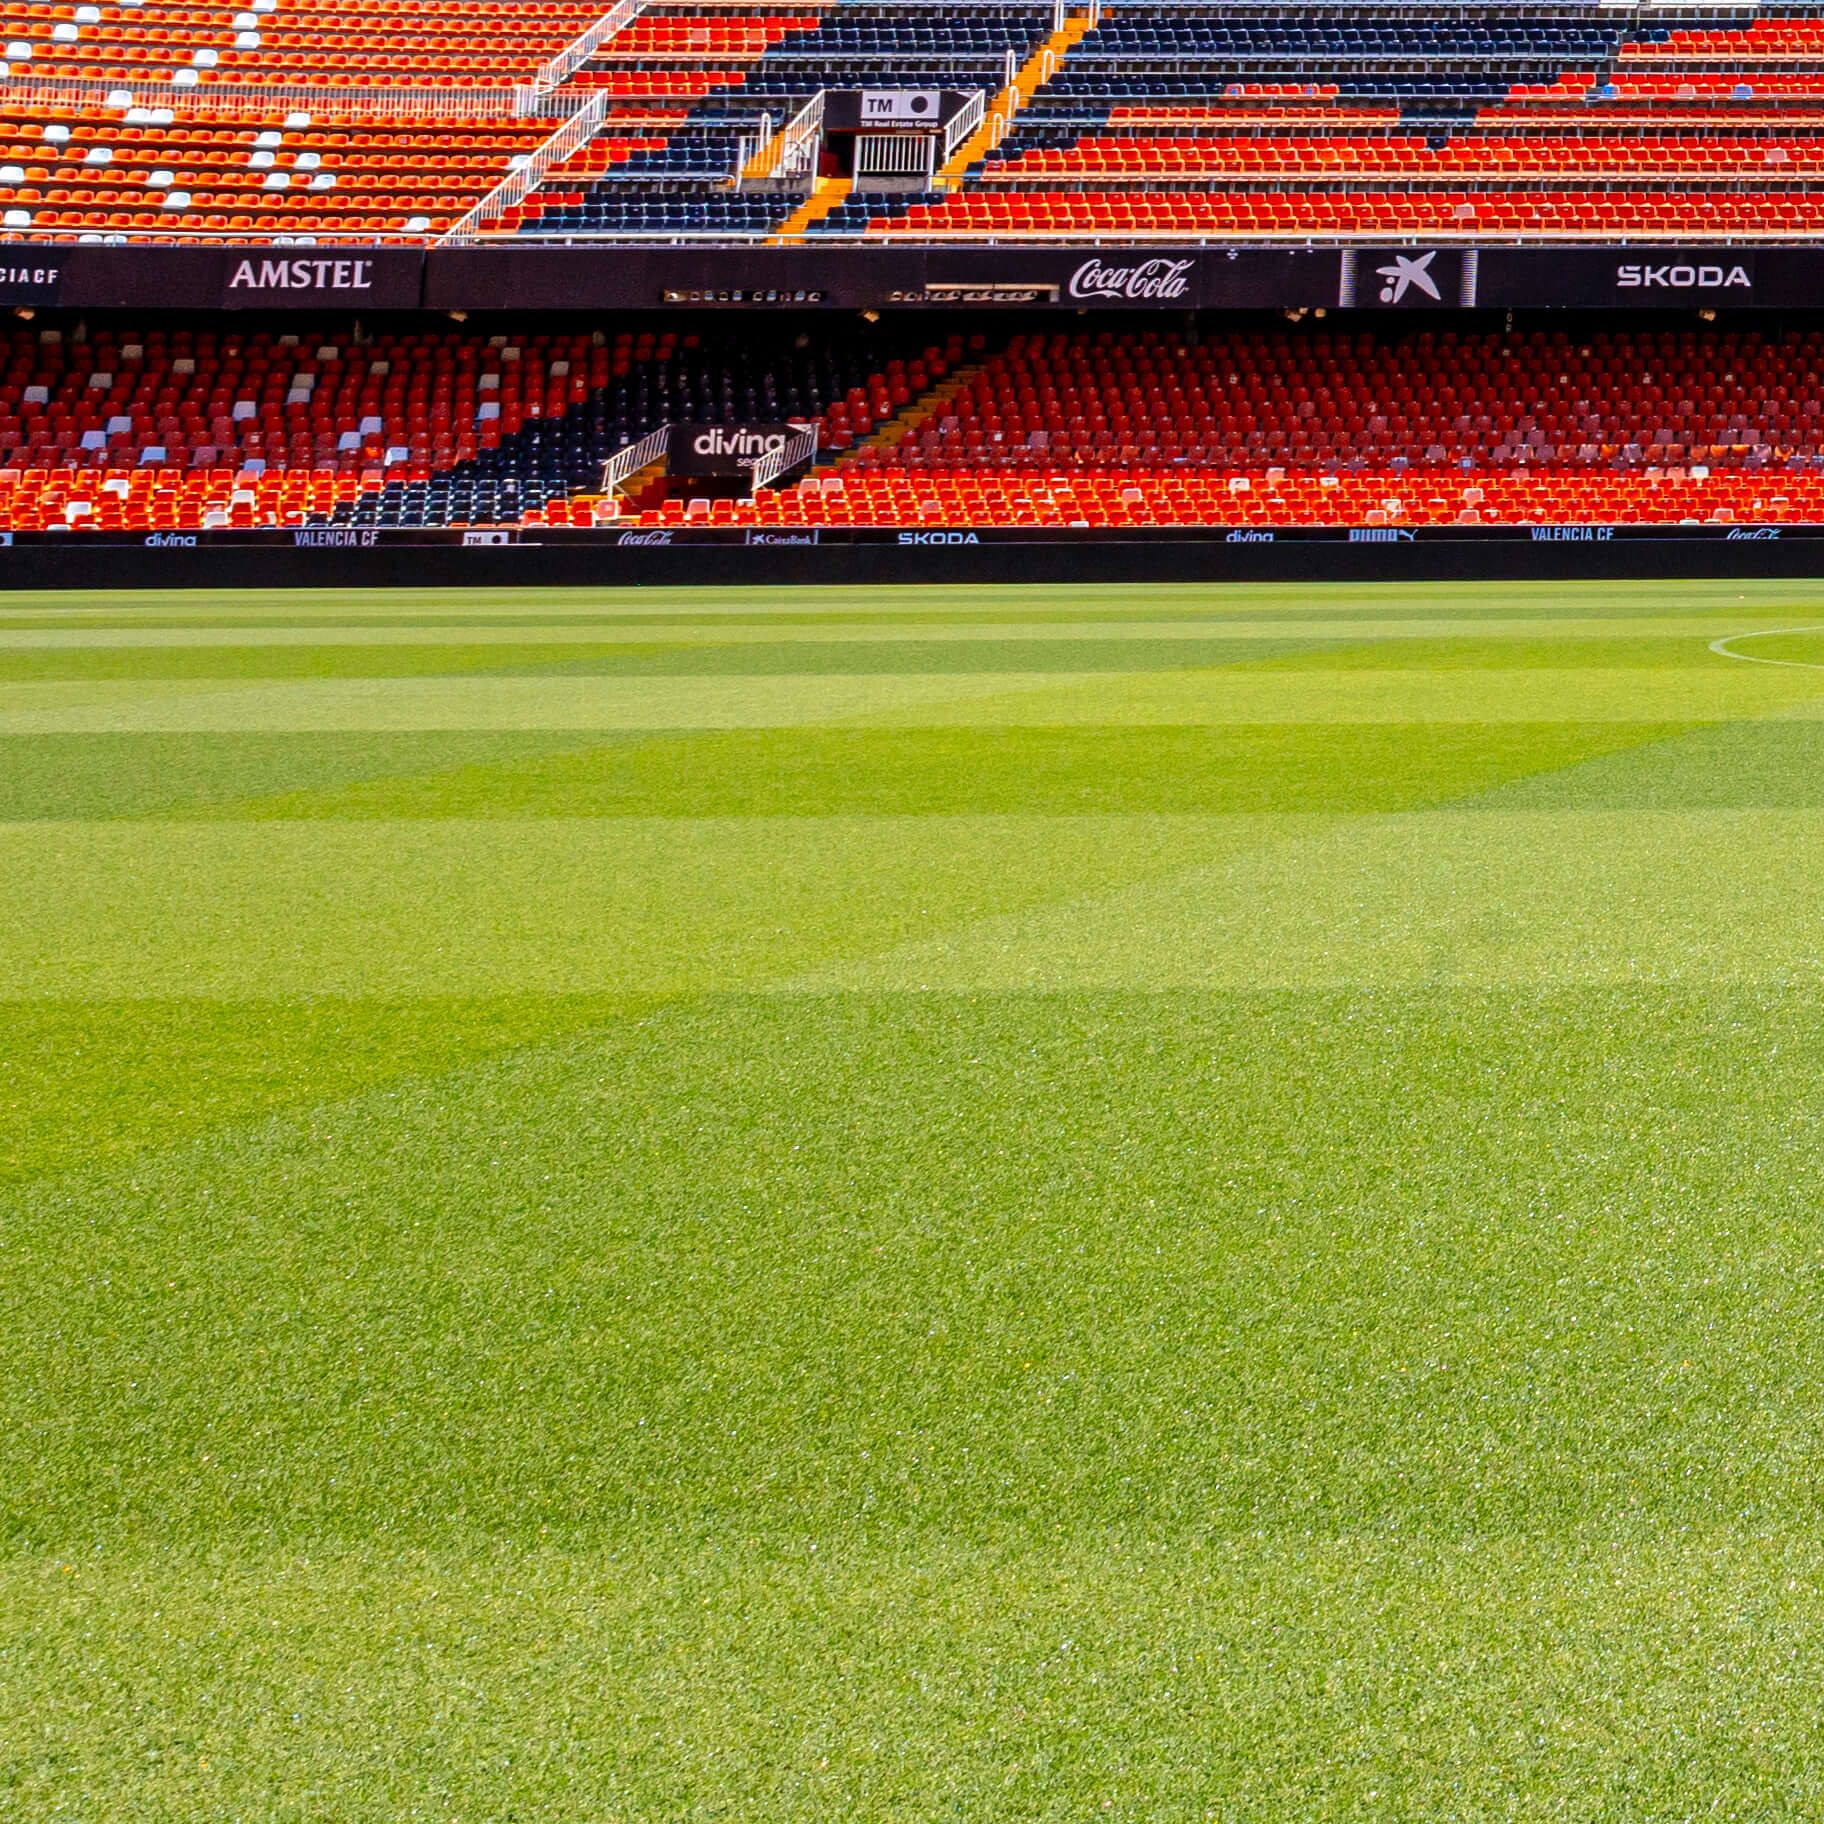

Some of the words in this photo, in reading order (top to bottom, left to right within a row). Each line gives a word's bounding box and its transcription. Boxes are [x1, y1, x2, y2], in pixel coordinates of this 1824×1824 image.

[868, 98, 893, 113] TM
[229, 259, 373, 288] AMSTEL
[1069, 259, 1196, 298] Coca-Cola
[694, 428, 786, 455] divina
[145, 531, 197, 546] divina
[294, 531, 358, 546] VALENCIA
[361, 531, 379, 546] CF
[1531, 527, 1593, 541] VALENCIA
[1596, 527, 1615, 541] CF
